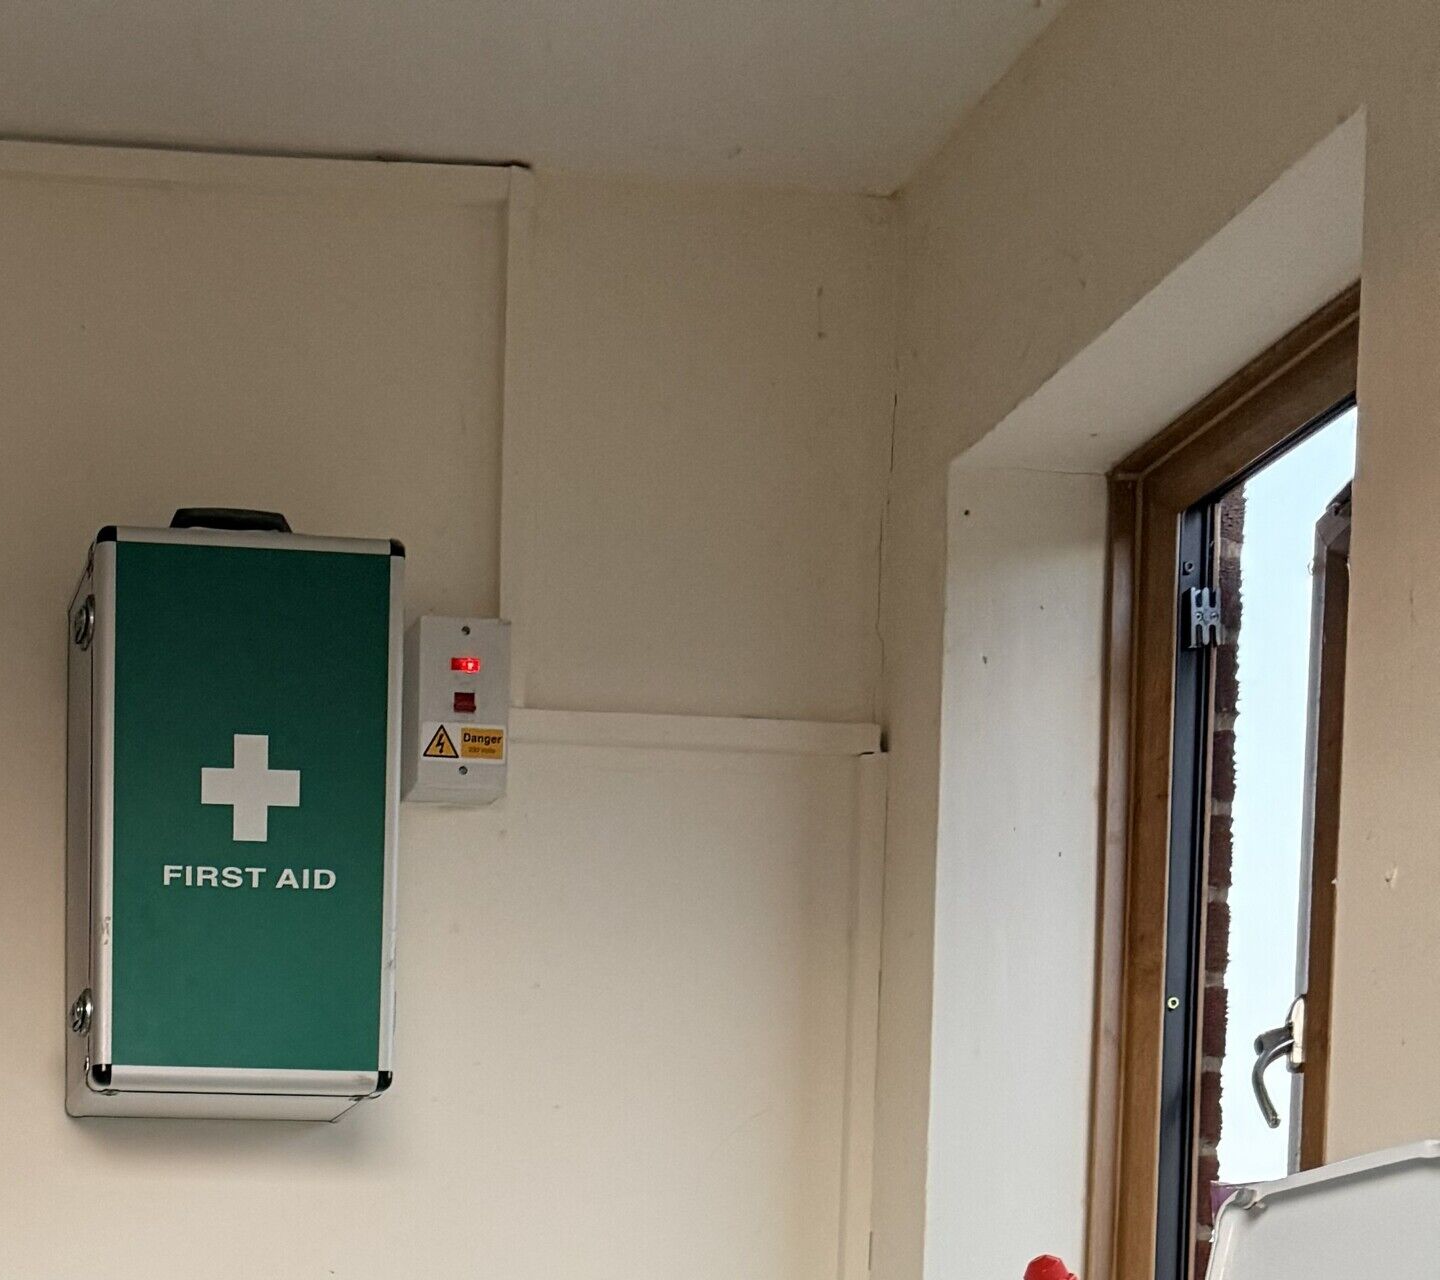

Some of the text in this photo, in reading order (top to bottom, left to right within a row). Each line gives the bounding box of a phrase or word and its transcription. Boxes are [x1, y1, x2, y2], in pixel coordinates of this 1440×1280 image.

[463, 732, 502, 745] Danger
[163, 864, 337, 890] FIRST AID
